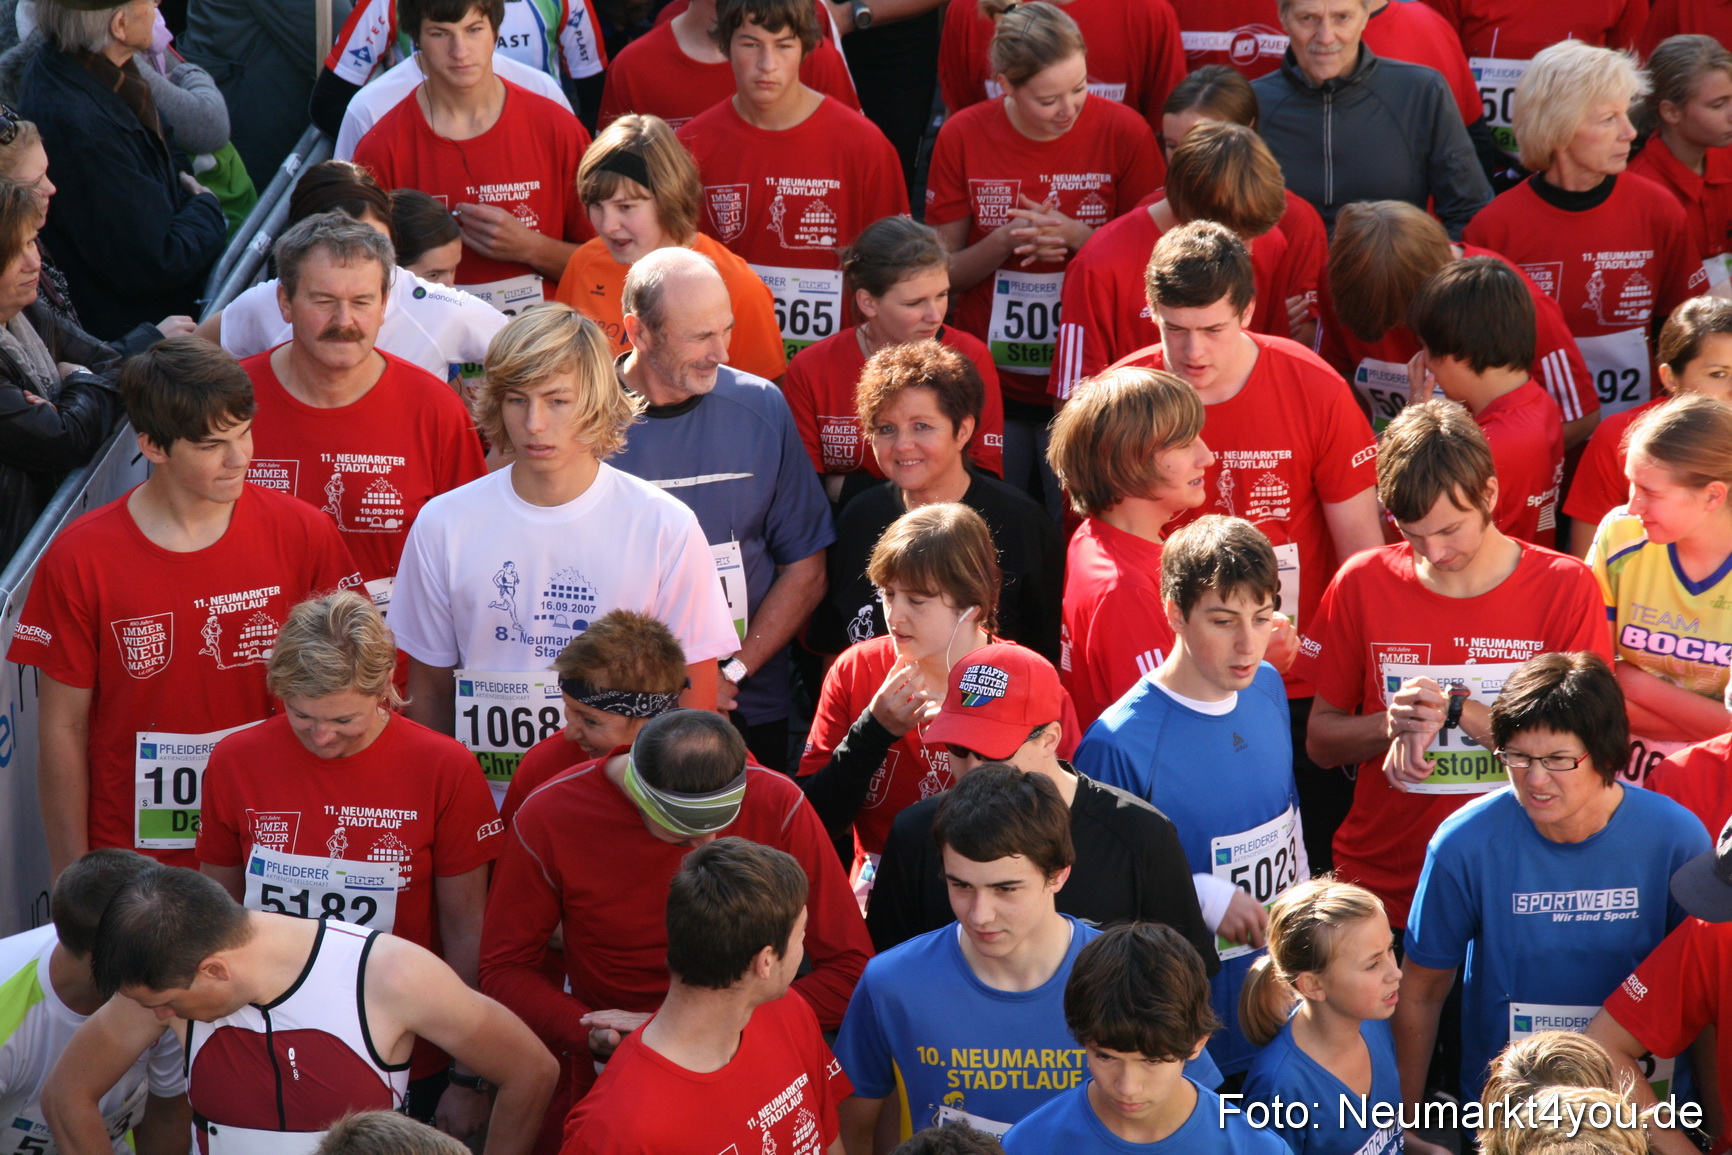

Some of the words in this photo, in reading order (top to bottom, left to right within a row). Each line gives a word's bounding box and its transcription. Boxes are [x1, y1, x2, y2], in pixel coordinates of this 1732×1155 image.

[766, 177, 778, 186] 11.
[779, 178, 840, 189] NEUMARKTER
[1039, 174, 1051, 182] 11.
[1052, 174, 1112, 183] NEUMARKTER
[466, 186, 478, 195] 11.
[480, 180, 540, 194] NEUMARKTER
[776, 186, 828, 196] STADTLAUF
[977, 186, 1011, 194] IMMER
[1051, 182, 1101, 190] STADTLAUF
[478, 191, 530, 202] STADTLAUF
[711, 193, 741, 202] IMMER
[976, 196, 1012, 204] WIEDER
[712, 202, 742, 211] WIEDER
[978, 205, 1010, 218] NEU
[716, 211, 740, 224] NEU
[979, 218, 1009, 226] MARKT
[1582, 253, 1596, 262] 11.
[1594, 260, 1646, 270] STADTLAUF
[504, 286, 532, 300] BOCK
[1010, 280, 1058, 293] PFLEIDERER
[1598, 368, 1640, 404] 92
[822, 424, 857, 434] IMMER
[820, 434, 858, 444] WIEDER
[823, 446, 855, 458] NEU
[1224, 450, 1292, 460] NEUMARKTER
[320, 453, 334, 463] 11.
[336, 454, 405, 466] NEUMARKTER
[824, 458, 855, 466] MARKT
[1222, 460, 1278, 469] STADTLAUF
[248, 468, 288, 479] IMMER
[334, 463, 392, 474] STADTLAUF
[1250, 497, 1290, 506] 19.09.2010
[360, 508, 404, 516] 19.09.2010
[194, 598, 208, 610] 11.
[210, 586, 281, 606] NEUMARKTER
[208, 598, 268, 616] STADTLAUF
[540, 601, 596, 614] 16.09.2007
[1631, 602, 1700, 634] TEAM
[122, 622, 164, 636] IMMER
[495, 626, 516, 642] 8.
[123, 632, 166, 647] WIEDER
[1453, 638, 1468, 648] 11.
[1620, 624, 1732, 666] BOCK
[127, 642, 164, 660] NEU
[1468, 648, 1533, 660] STADTLAUF
[128, 656, 166, 670] MARKT
[1379, 652, 1420, 664] IMMER
[966, 665, 980, 674] DIE
[980, 665, 1010, 682] KAPPE
[474, 680, 529, 694] PFLEIDERER
[962, 674, 978, 682] DER
[978, 675, 1008, 690] GUTEN
[958, 682, 1005, 698] HOFFNUNG!
[463, 704, 561, 748] 1068
[144, 766, 201, 805] 10
[324, 806, 338, 816] 11.
[341, 806, 418, 820] NEUMARKTER
[338, 816, 402, 830] STADTLAUF
[1234, 830, 1279, 856] PFLEIDERER
[266, 860, 329, 881] PFLEIDERER
[344, 875, 385, 886] BOCK
[1231, 836, 1297, 903] 5023
[265, 873, 328, 888] AKTIENGESELLSCHAFT
[260, 884, 378, 926] 5182
[1516, 890, 1638, 912] SPORTWEISS
[1552, 912, 1572, 922] Wir
[1575, 911, 1600, 922] sind
[1603, 910, 1639, 922] Sport.
[1535, 1016, 1592, 1028] PFLEIDER
[916, 1046, 946, 1066] 10.
[947, 1070, 1082, 1090] STADTLAUF
[746, 1116, 760, 1130] 11.
[757, 1072, 808, 1122] NEUMARKTER
[760, 1090, 804, 1132] STADTLAUF
